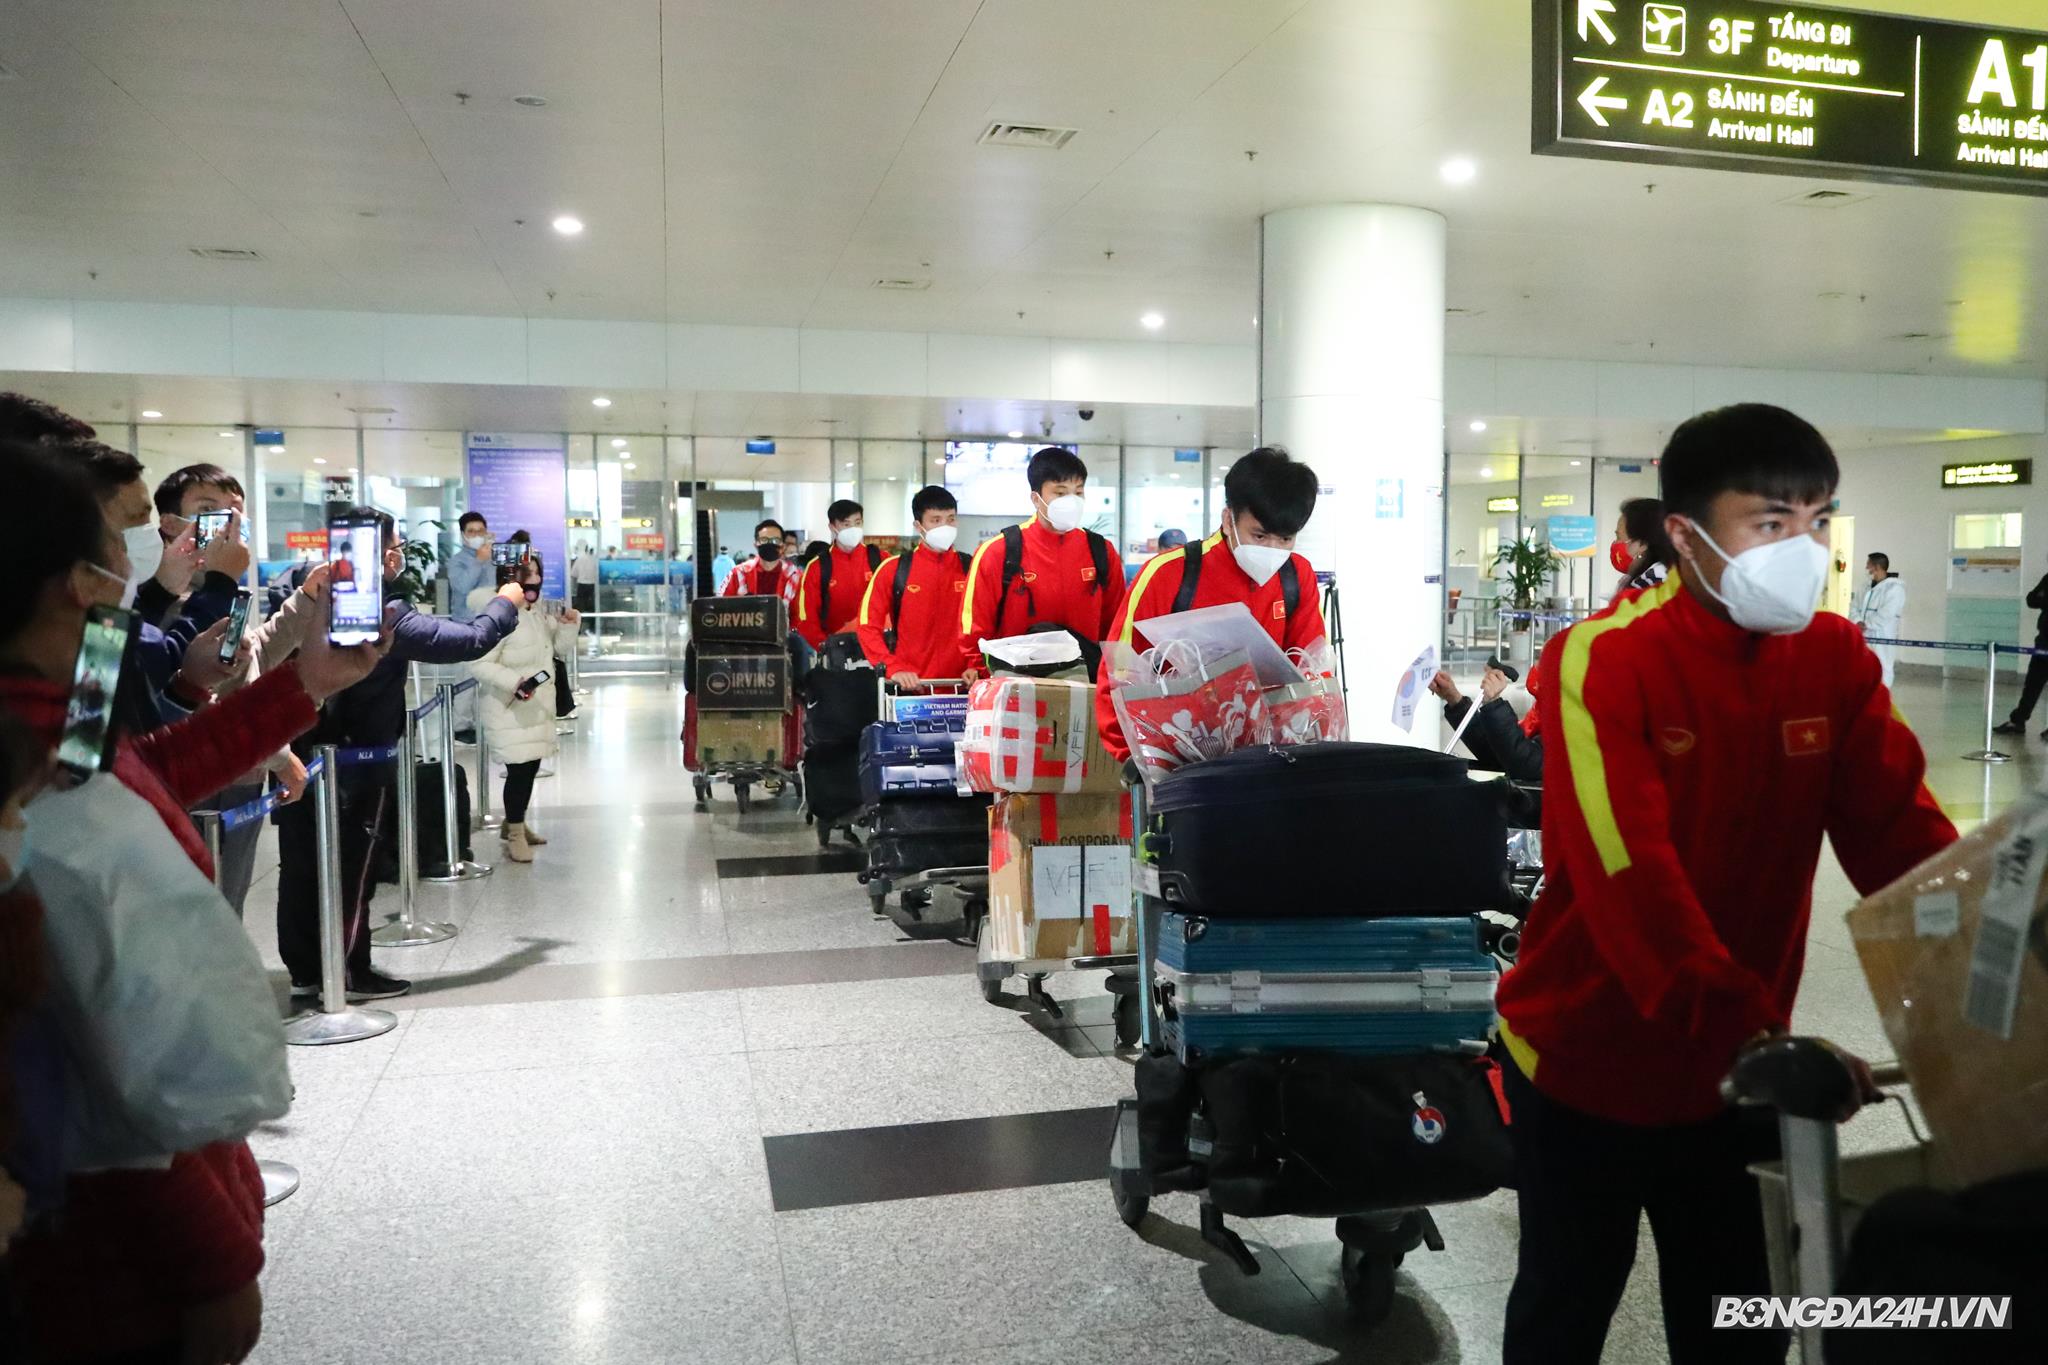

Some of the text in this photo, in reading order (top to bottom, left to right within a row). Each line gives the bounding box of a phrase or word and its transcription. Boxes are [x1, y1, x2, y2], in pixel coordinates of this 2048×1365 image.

[1708, 18, 1754, 55] 3F
[1830, 24, 1851, 46] ĐI
[1767, 46, 1860, 76] Departure
[1966, 38, 2047, 110] A1
[1642, 88, 1694, 129] A2
[1707, 82, 1814, 118] SẢNH ĐẾN
[1707, 117, 1814, 147] Arrival Hall
[1957, 109, 2010, 138] SẢNH
[1957, 142, 2048, 169] Arrival Hal
[718, 611, 764, 627] IRVINS
[731, 672, 776, 688] IRVINS
[923, 703, 950, 711] VIETNAM
[1069, 714, 1084, 769] VFF
[1045, 862, 1105, 897] VFF
